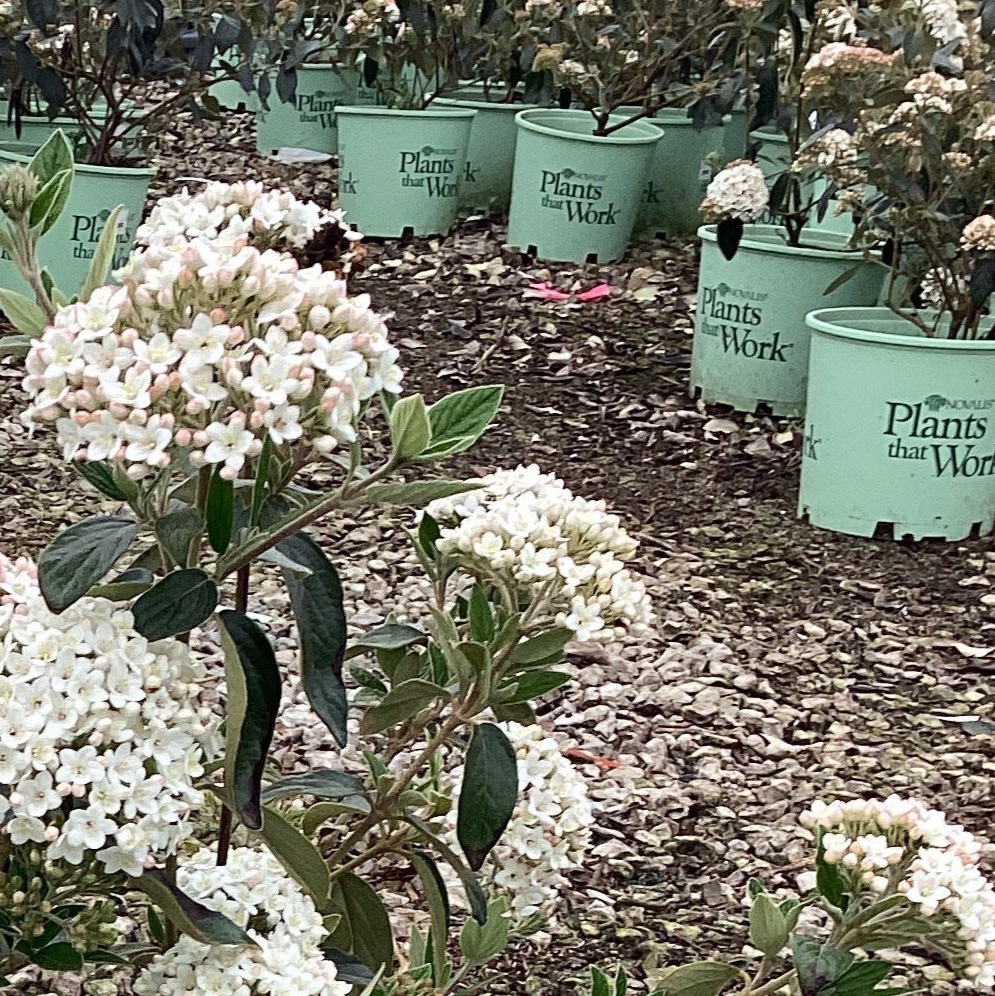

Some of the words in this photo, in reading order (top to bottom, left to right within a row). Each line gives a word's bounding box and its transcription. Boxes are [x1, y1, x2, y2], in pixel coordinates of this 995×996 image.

[399, 151, 454, 174] Plants
[402, 174, 424, 187] that
[540, 170, 603, 200] Plants
[541, 194, 563, 210] that
[565, 199, 619, 225] Work
[73, 242, 95, 259] tha
[701, 287, 762, 326] Plants
[720, 324, 792, 362] Work
[883, 401, 988, 440] Plants
[888, 438, 929, 460] that
